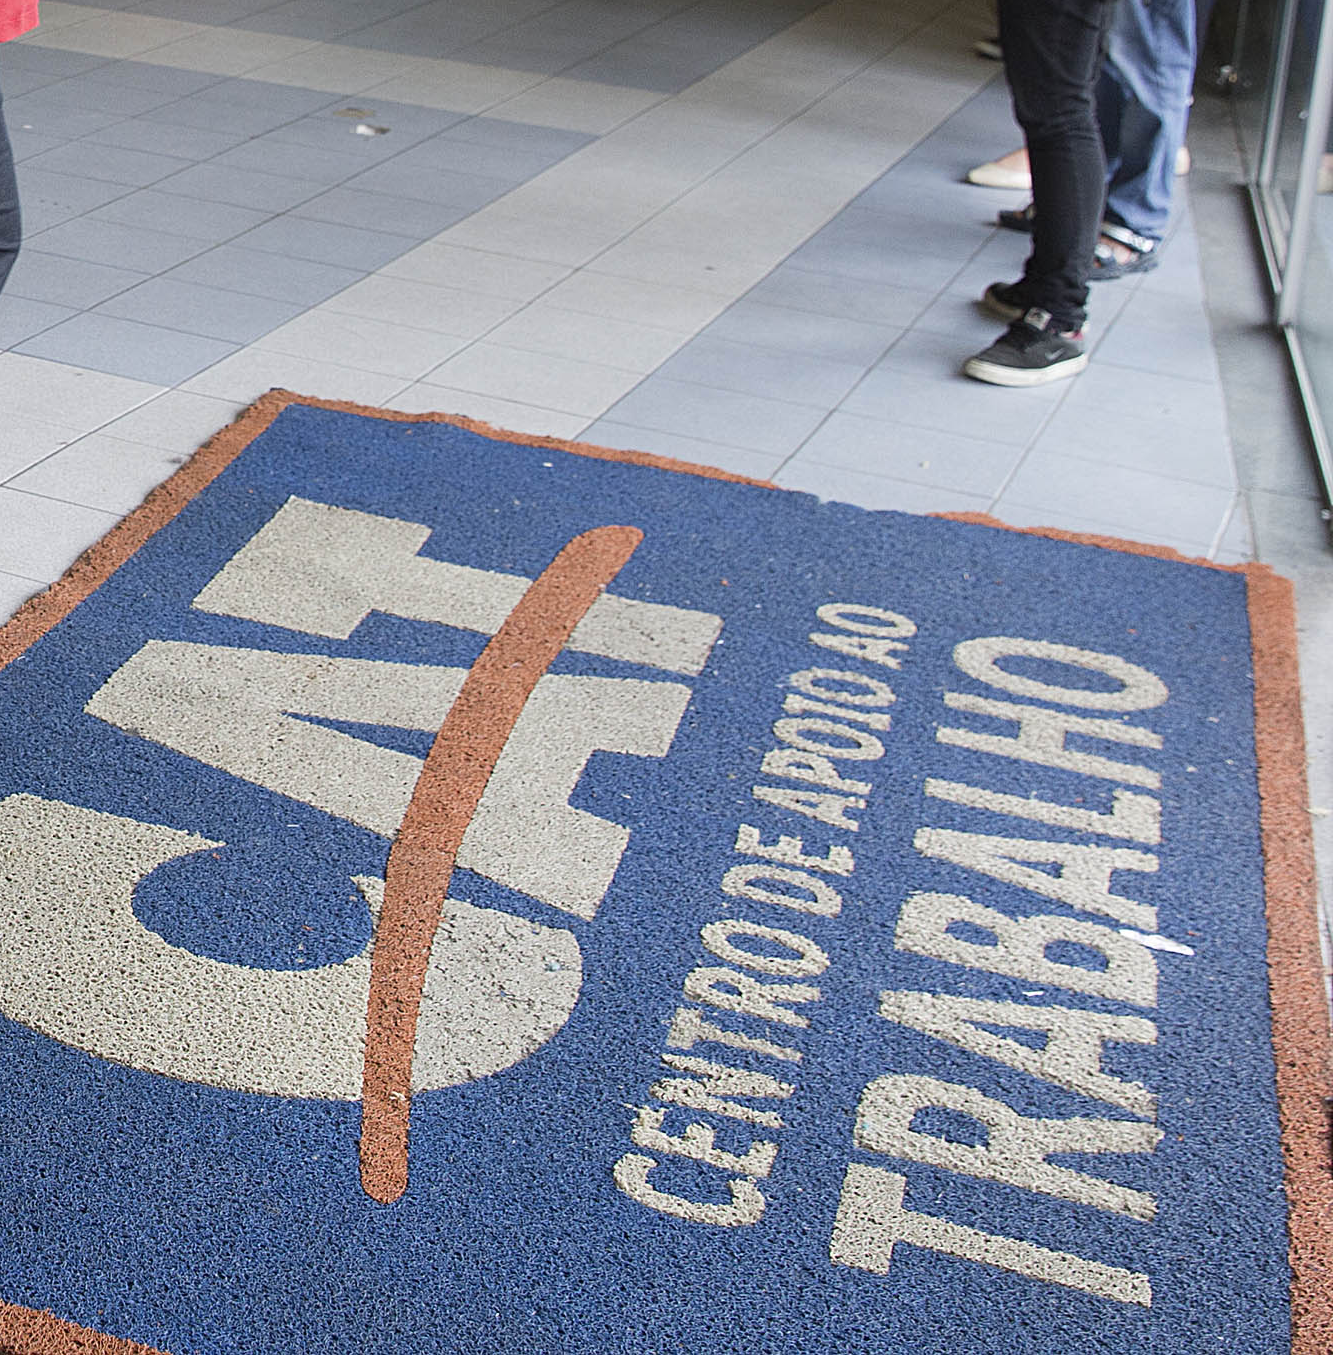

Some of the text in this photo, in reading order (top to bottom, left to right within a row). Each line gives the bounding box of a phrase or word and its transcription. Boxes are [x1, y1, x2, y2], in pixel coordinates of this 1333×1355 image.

[613, 600, 920, 1229] CENTRO DE APOIO AO
[829, 634, 1171, 1308] TRABALHO
